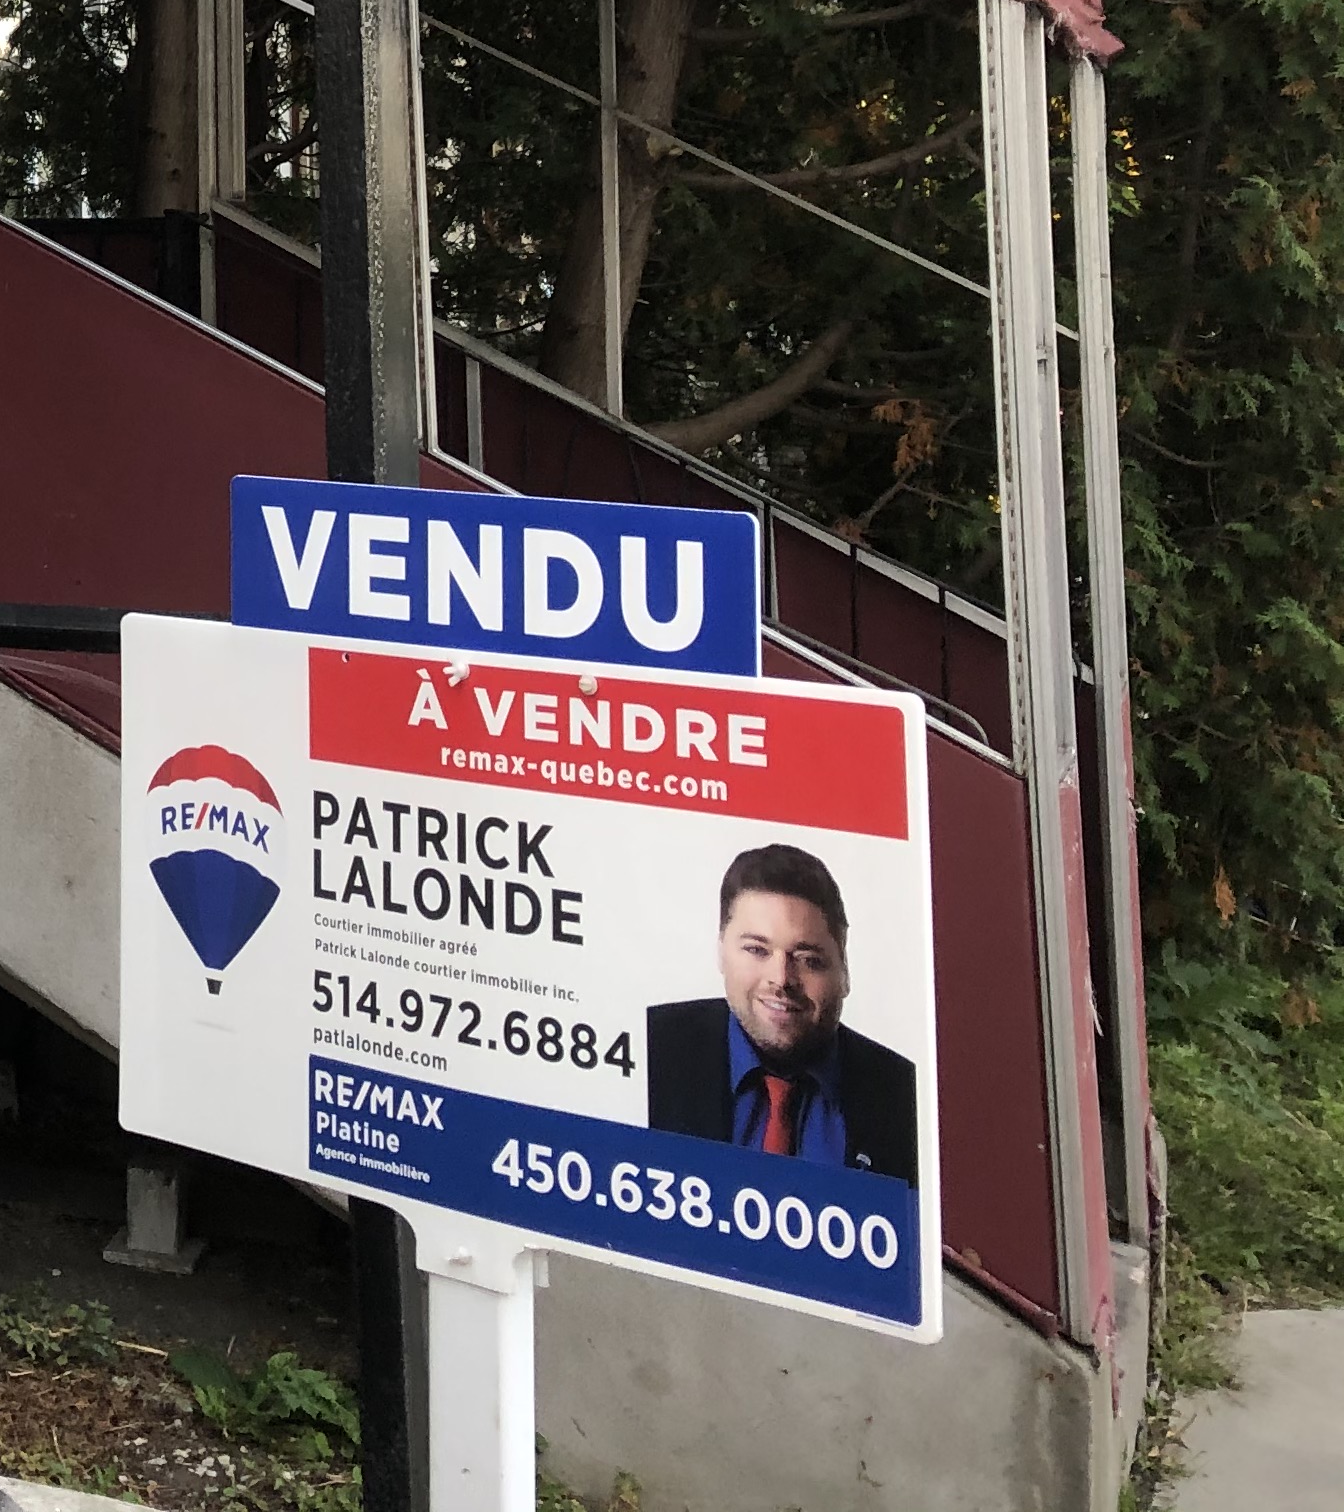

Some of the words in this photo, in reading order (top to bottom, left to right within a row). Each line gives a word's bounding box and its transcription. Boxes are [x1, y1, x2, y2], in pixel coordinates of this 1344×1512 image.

[261, 505, 705, 654] VENDU
[408, 668, 448, 731] À
[474, 685, 768, 767] VENDRE
[440, 743, 728, 803] remax-quebec.com
[161, 801, 272, 854] RE/MAX
[312, 790, 555, 879] PATRICK
[312, 849, 585, 946] LALONDE
[314, 912, 363, 934] Courtier
[367, 923, 435, 949] immobilier
[439, 935, 478, 956] agréé
[315, 938, 357, 958] Patrick
[361, 947, 410, 969] Lalonde
[414, 959, 466, 981] courtier
[471, 969, 548, 997] immobilier
[553, 985, 580, 1003] inc.
[312, 969, 636, 1078] 514.972.6884
[313, 1026, 448, 1072] patlalonde.com
[314, 1069, 444, 1131] RE/MAX
[315, 1143, 357, 1165] Agence
[359, 1153, 431, 1184] immobilière
[316, 1112, 400, 1153] Platine
[491, 1138, 899, 1270] 450.638.0000
